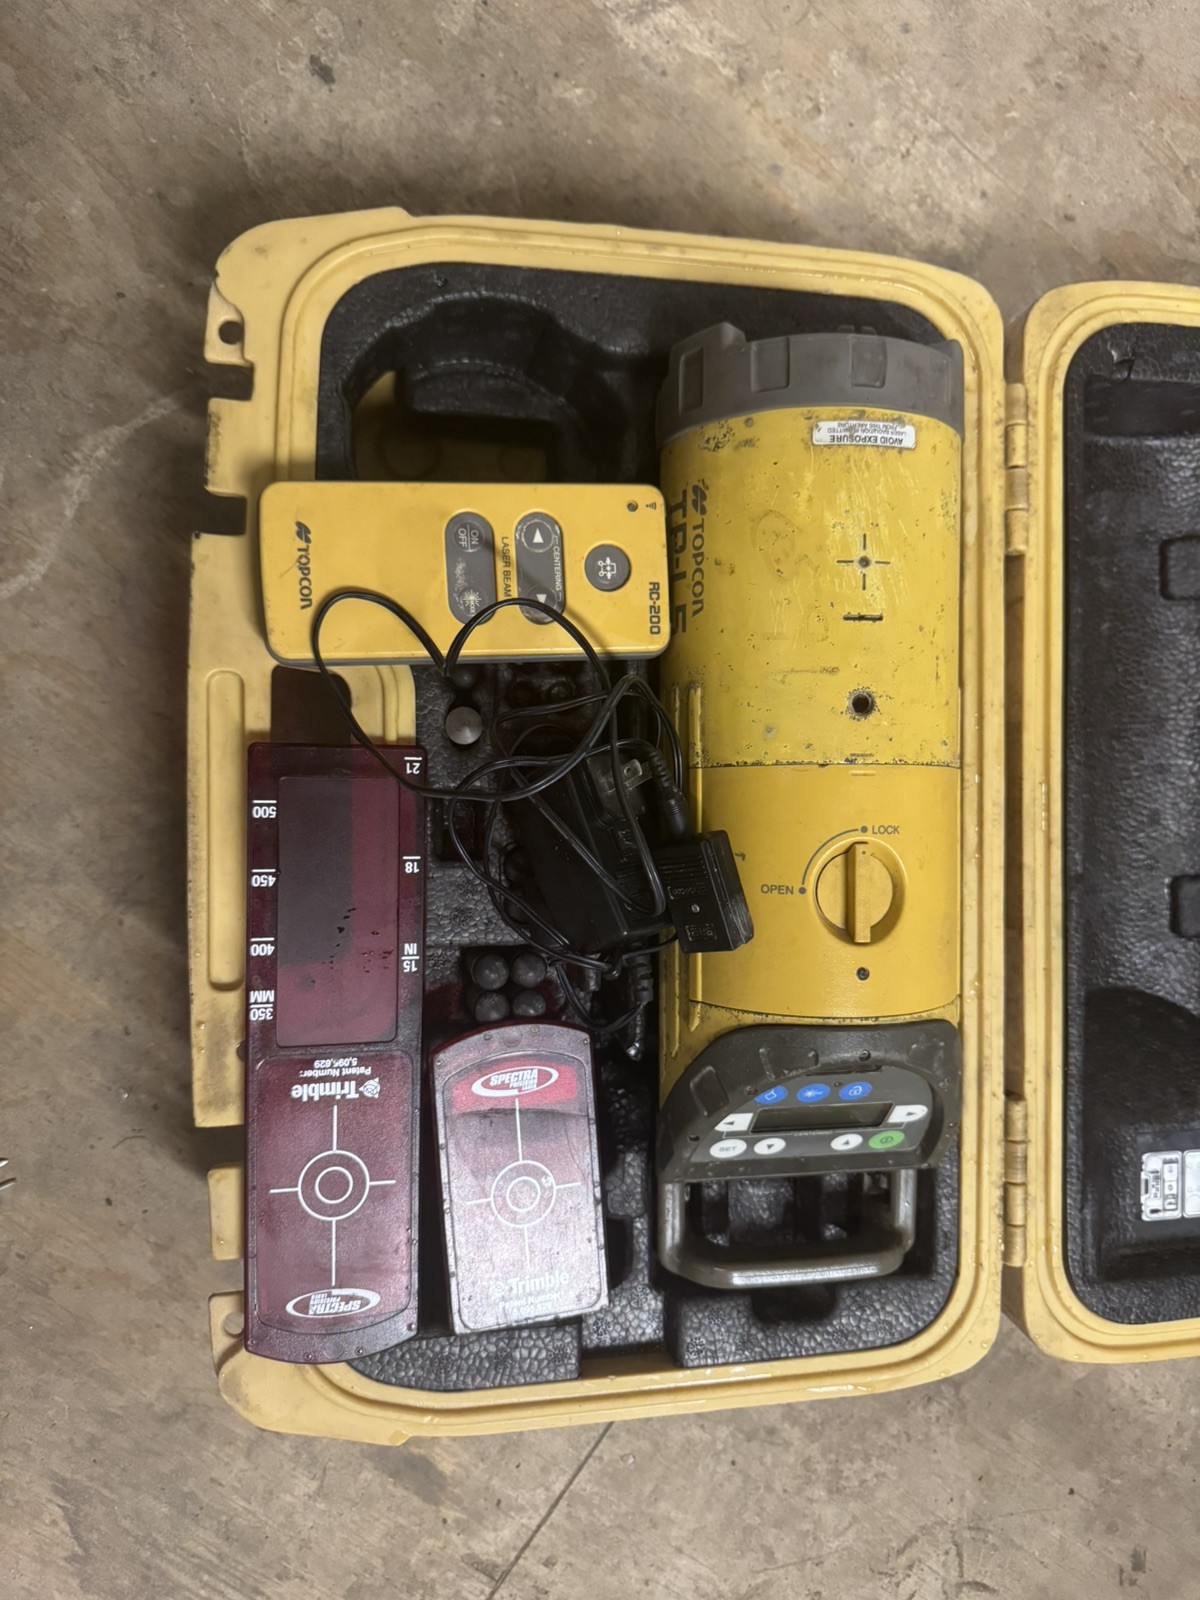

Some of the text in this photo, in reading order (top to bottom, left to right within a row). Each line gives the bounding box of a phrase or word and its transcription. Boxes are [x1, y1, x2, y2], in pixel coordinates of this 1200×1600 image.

[829, 434, 904, 446] AVOID EXPOSURE
[457, 527, 468, 549] OFF
[470, 529, 480, 545] ON
[501, 536, 512, 598] LASER BEAM
[552, 545, 563, 591] CENTERING
[691, 518, 705, 618] TOPCON
[296, 544, 313, 610] TOPCON
[648, 581, 661, 635] RC-200
[405, 761, 421, 775] 21
[252, 805, 278, 819] 500
[871, 824, 900, 835] LOCK
[404, 861, 421, 874] 18
[251, 874, 277, 888] 450
[760, 884, 795, 895] OPEN
[250, 943, 276, 957] 400
[403, 942, 418, 956] IN
[402, 959, 418, 972] 15
[249, 989, 275, 1003] MM
[249, 1007, 274, 1021] 350
[299, 1066, 372, 1078] Patent Number:
[490, 1068, 538, 1086] SPECTRA
[290, 1080, 360, 1102] Trimble
[718, 1145, 738, 1153] SET
[508, 1269, 569, 1295] Trimble
[308, 1300, 361, 1315] SPECTRA
